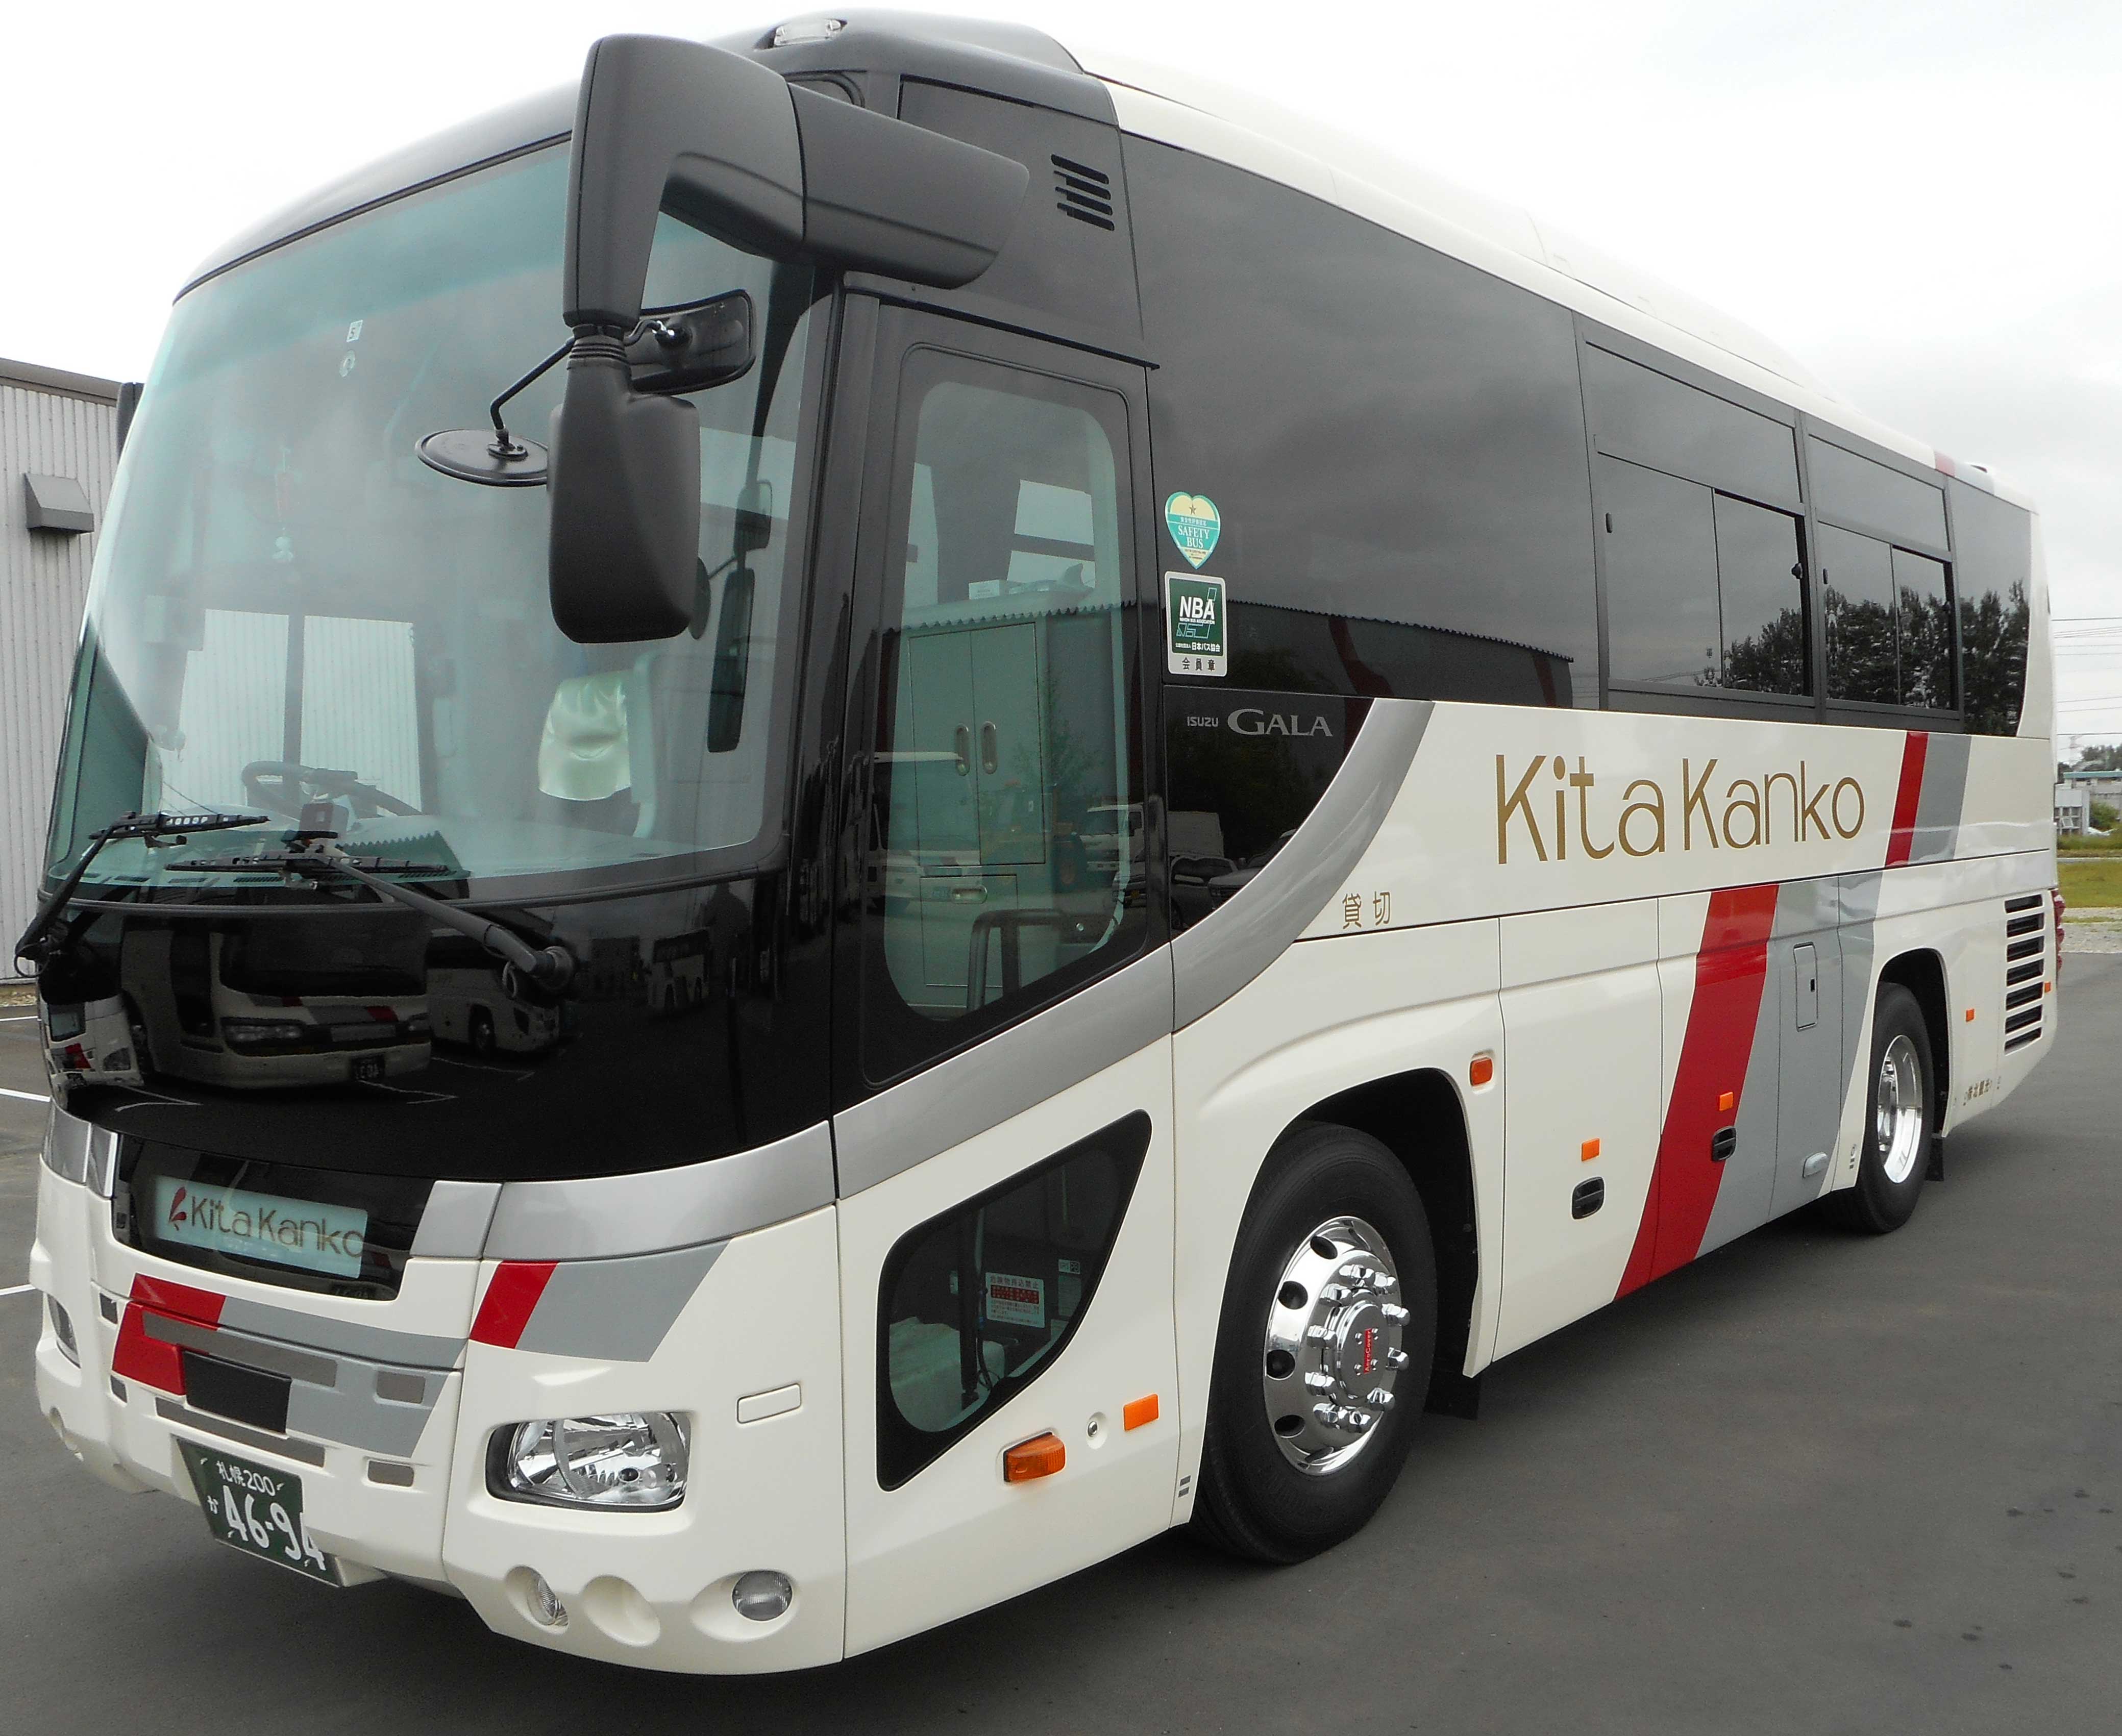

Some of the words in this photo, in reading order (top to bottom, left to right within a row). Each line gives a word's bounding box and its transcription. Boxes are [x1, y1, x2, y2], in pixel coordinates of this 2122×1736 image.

[1178, 525, 1210, 539] SAFETY
[1187, 537, 1203, 549] BUS
[1179, 596, 1215, 620] NBA
[1192, 642, 1220, 652] 日本バス協会
[1182, 657, 1215, 672] 会員章
[1187, 716, 1219, 727] ISUZU
[1227, 708, 1333, 737] GALA
[1342, 891, 1391, 929] 貸切
[207, 1495, 218, 1515] か
